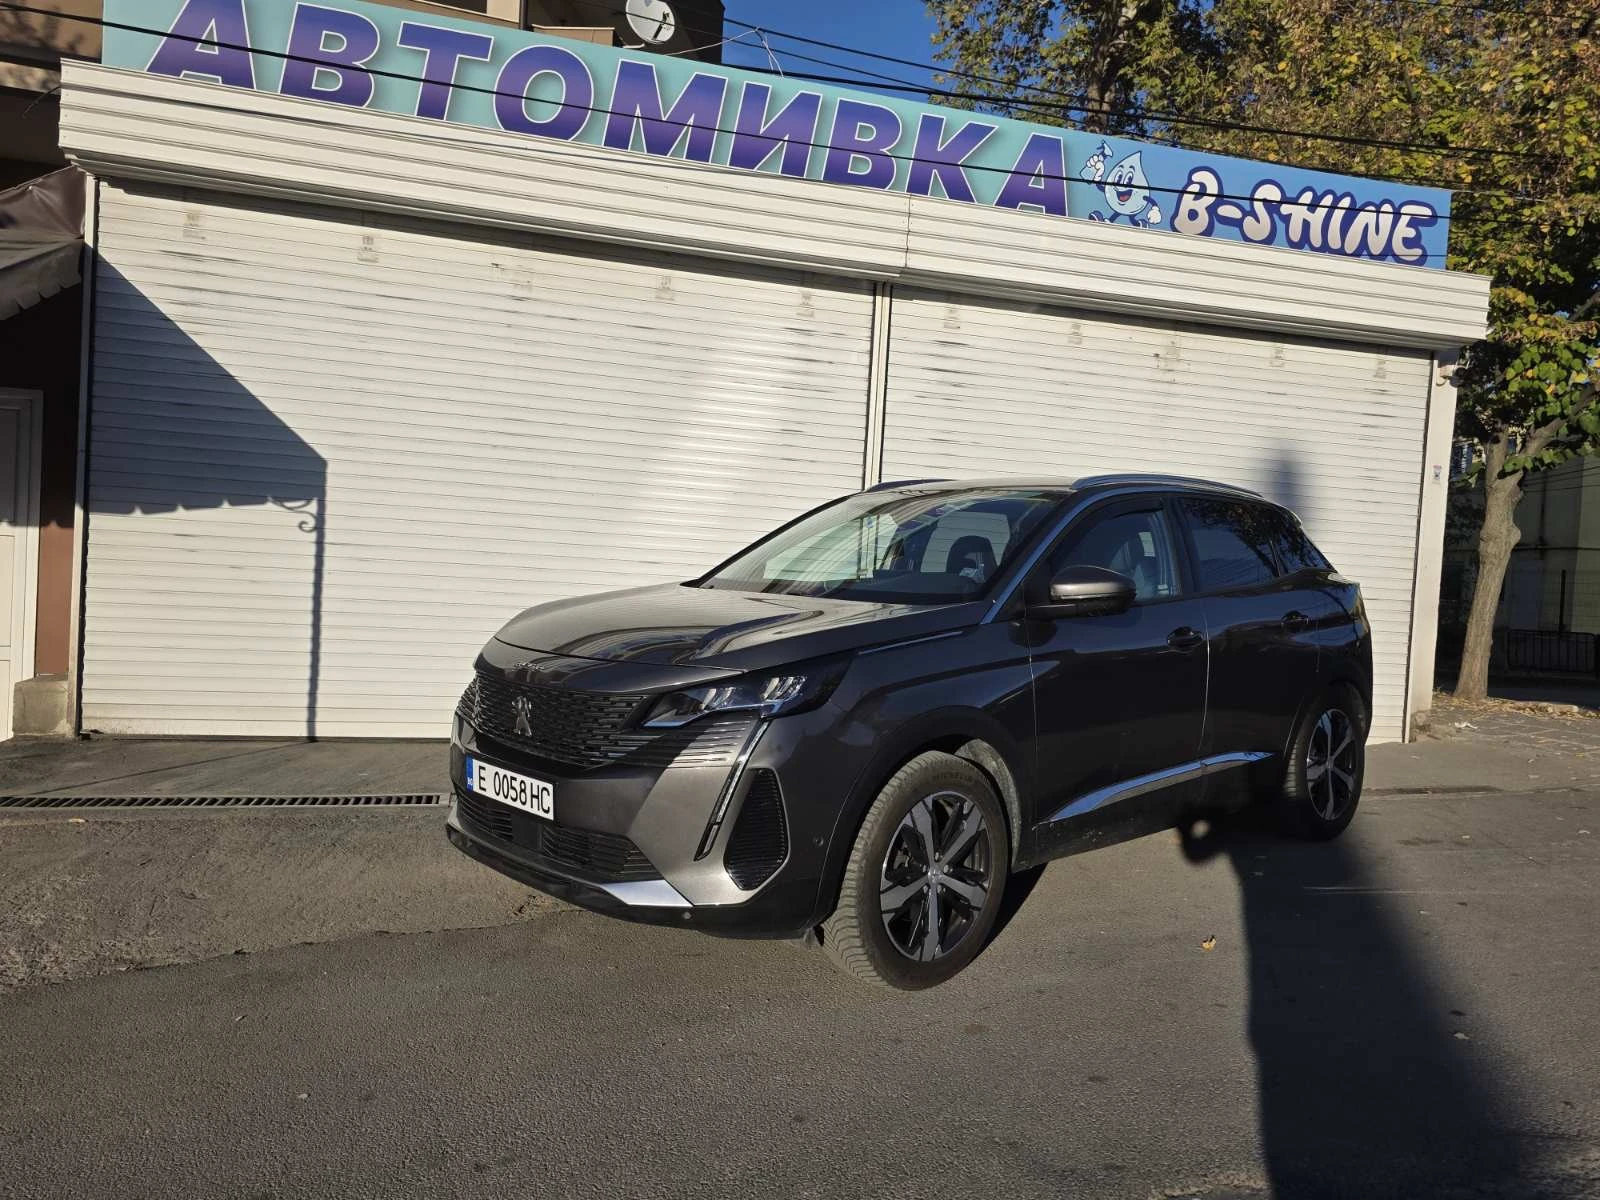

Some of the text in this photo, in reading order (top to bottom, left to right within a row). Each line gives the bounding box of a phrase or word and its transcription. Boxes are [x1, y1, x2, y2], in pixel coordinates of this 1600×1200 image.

[145, 0, 1070, 218] АВТОМИВКА
[1171, 167, 1437, 265] B-SHINE
[478, 765, 550, 814] E 0058 HC
